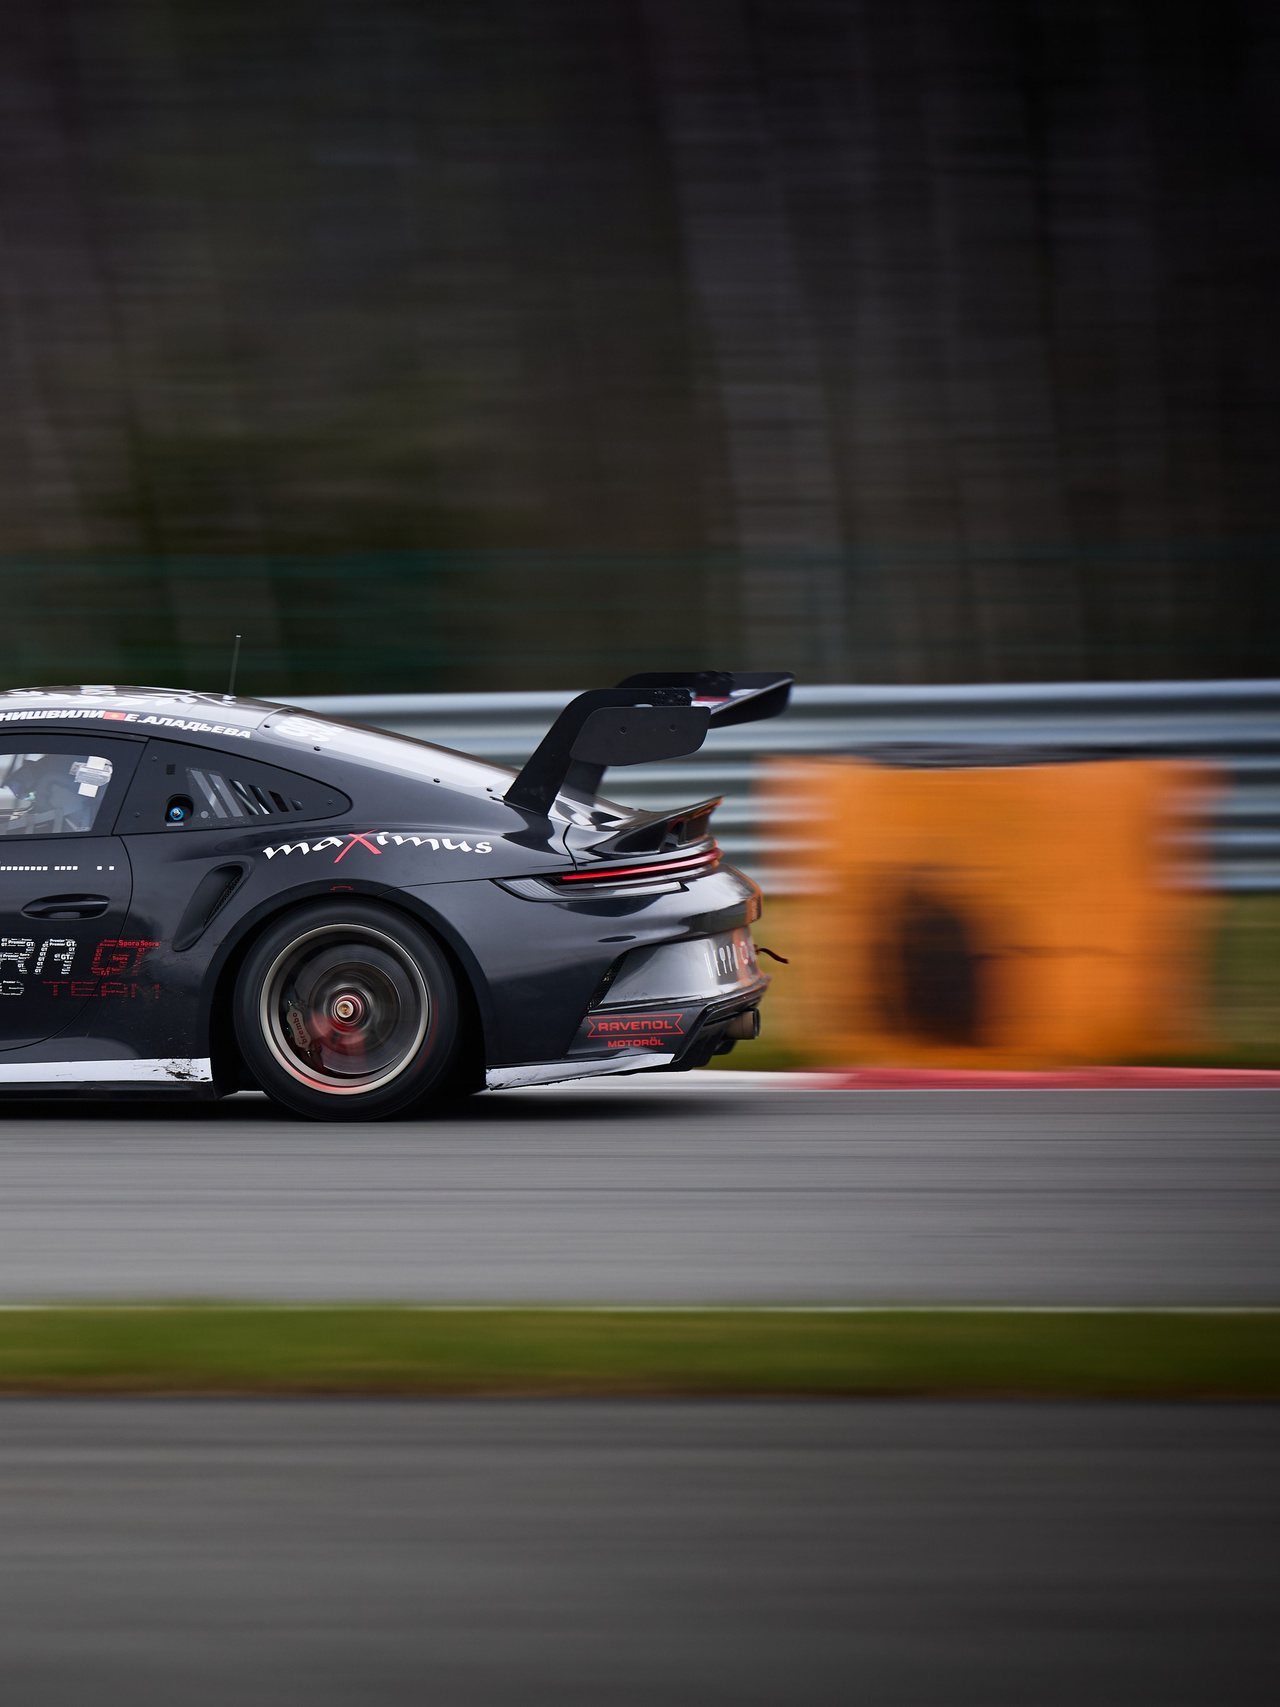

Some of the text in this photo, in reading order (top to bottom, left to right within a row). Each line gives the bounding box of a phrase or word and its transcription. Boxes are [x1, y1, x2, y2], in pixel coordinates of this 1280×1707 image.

[123, 713, 252, 740] Е.АЛАДЬЕВА
[43, 980, 161, 999] TEAM
[292, 1012, 308, 1045] brembo
[598, 1020, 673, 1031] RAVENOL
[607, 1037, 664, 1048] MOTORÖL
